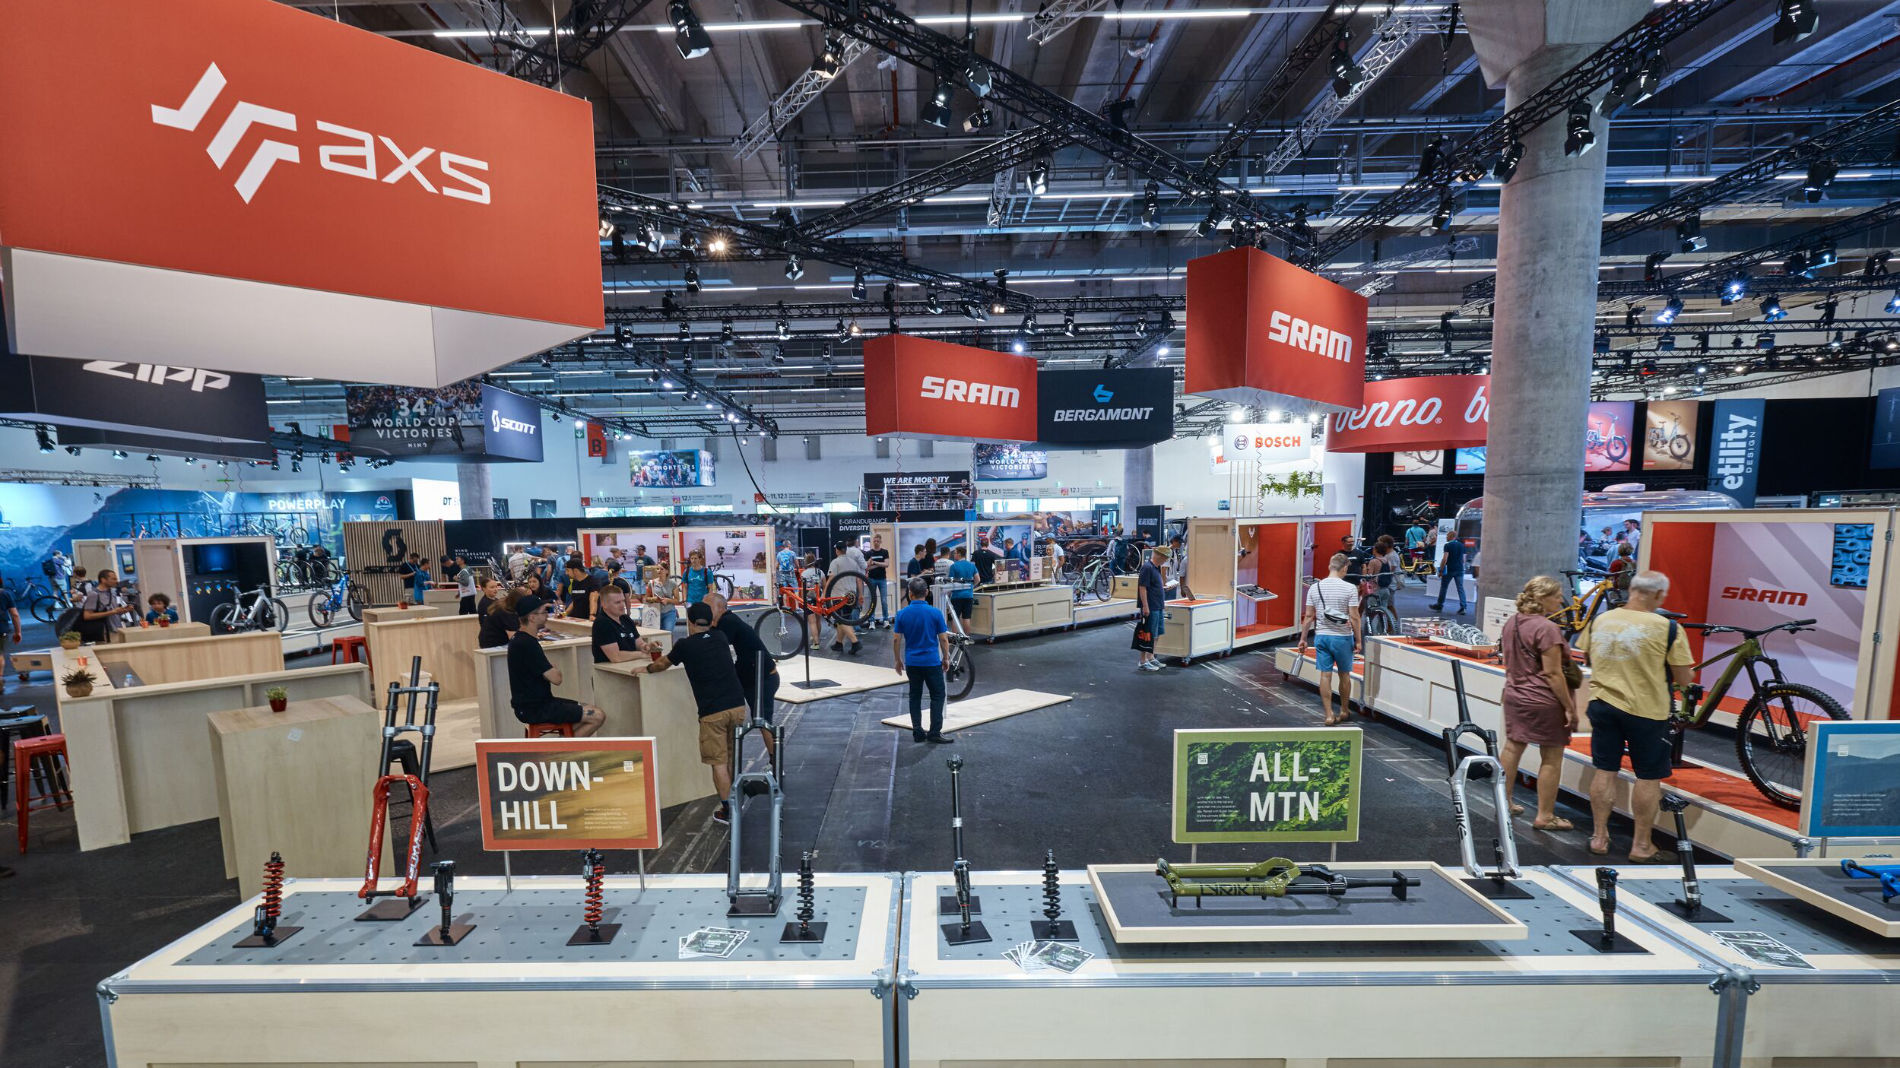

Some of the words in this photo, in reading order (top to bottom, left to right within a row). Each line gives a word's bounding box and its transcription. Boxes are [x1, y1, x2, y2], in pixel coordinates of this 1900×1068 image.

[1268, 310, 1353, 363] SRAM
[920, 375, 1020, 408] SRAM
[398, 398, 427, 416] 34
[1053, 407, 1154, 422] BERGAMONT
[372, 417, 421, 428] WORLD
[428, 417, 455, 427] CUP
[377, 428, 453, 439] VICTORIES
[500, 418, 536, 434] SCOTT
[1255, 436, 1301, 448] BOSCH
[1717, 414, 1758, 490] etility
[1745, 431, 1757, 474] DESIGN
[268, 499, 346, 510] POWERPLAY
[1721, 586, 1808, 607] SRAM
[496, 761, 604, 792] DOWN-
[1250, 752, 1321, 782] ALL-
[500, 800, 568, 830] HILL
[1250, 792, 1319, 823] MTN
